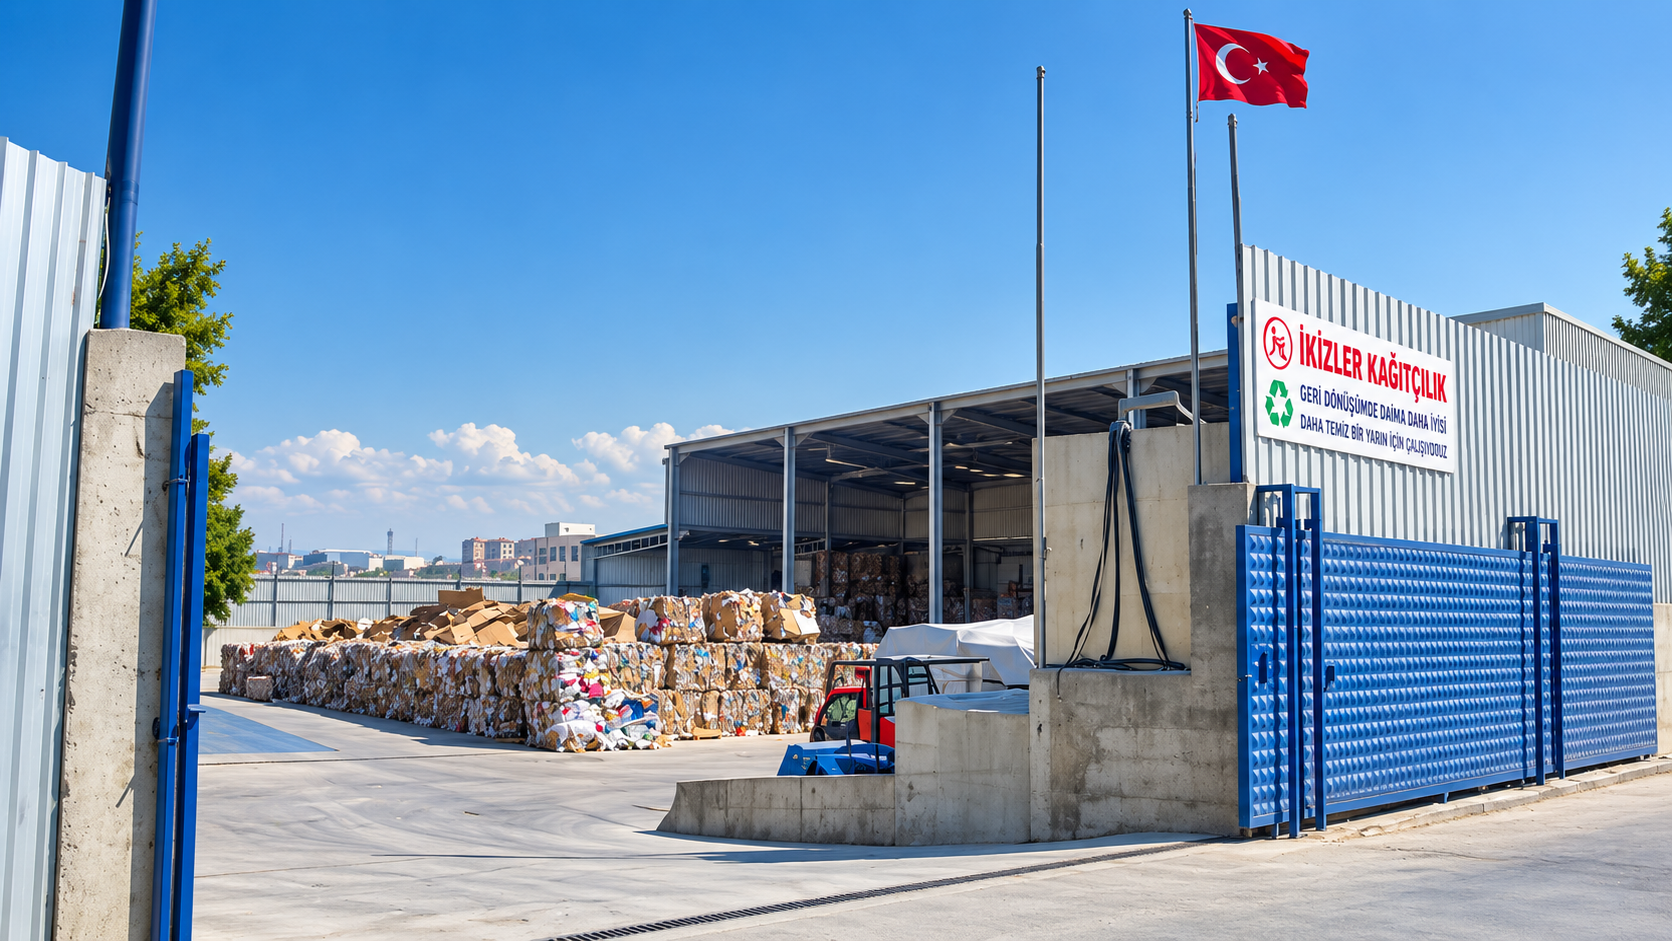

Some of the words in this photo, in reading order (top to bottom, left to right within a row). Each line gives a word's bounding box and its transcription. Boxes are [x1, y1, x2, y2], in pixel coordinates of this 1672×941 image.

[1299, 324, 1363, 380] İKİZLER
[1367, 352, 1447, 403] KAĞITÇILIK
[1300, 384, 1321, 405] GERİ
[1380, 403, 1406, 425] DAİMA
[1408, 411, 1429, 430] DAHA
[1430, 413, 1447, 434] İYİSİ
[1300, 414, 1324, 433] DAHA
[1325, 420, 1349, 438] TEMİZ
[1351, 423, 1364, 442] BİR
[1365, 428, 1388, 446] YARIN
[1389, 431, 1404, 452] İÇİN
